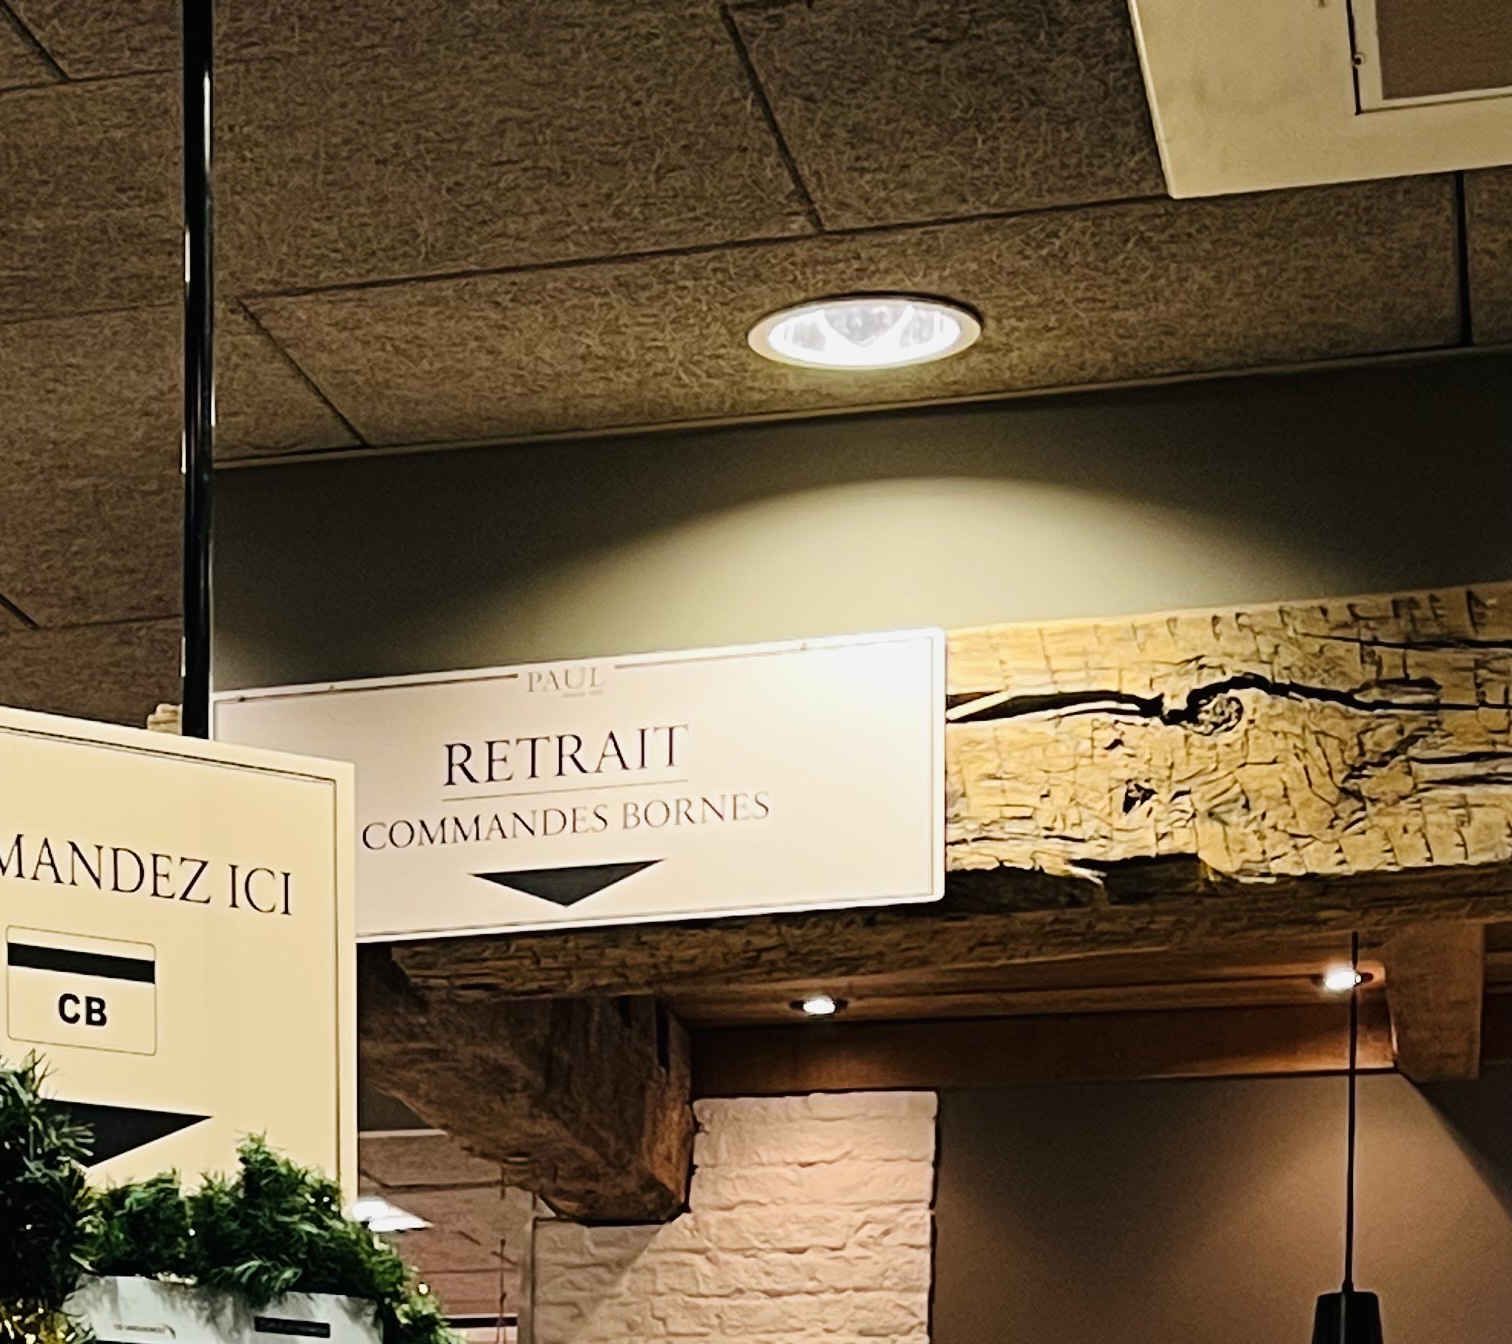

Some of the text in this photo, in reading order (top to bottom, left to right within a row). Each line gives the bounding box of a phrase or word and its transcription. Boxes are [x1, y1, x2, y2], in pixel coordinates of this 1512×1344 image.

[527, 666, 605, 693] PAUL
[443, 724, 689, 787] RETRAIT
[362, 791, 770, 850] COMMANDES BORNES
[229, 863, 292, 916] ICI
[57, 993, 108, 1027] CB
